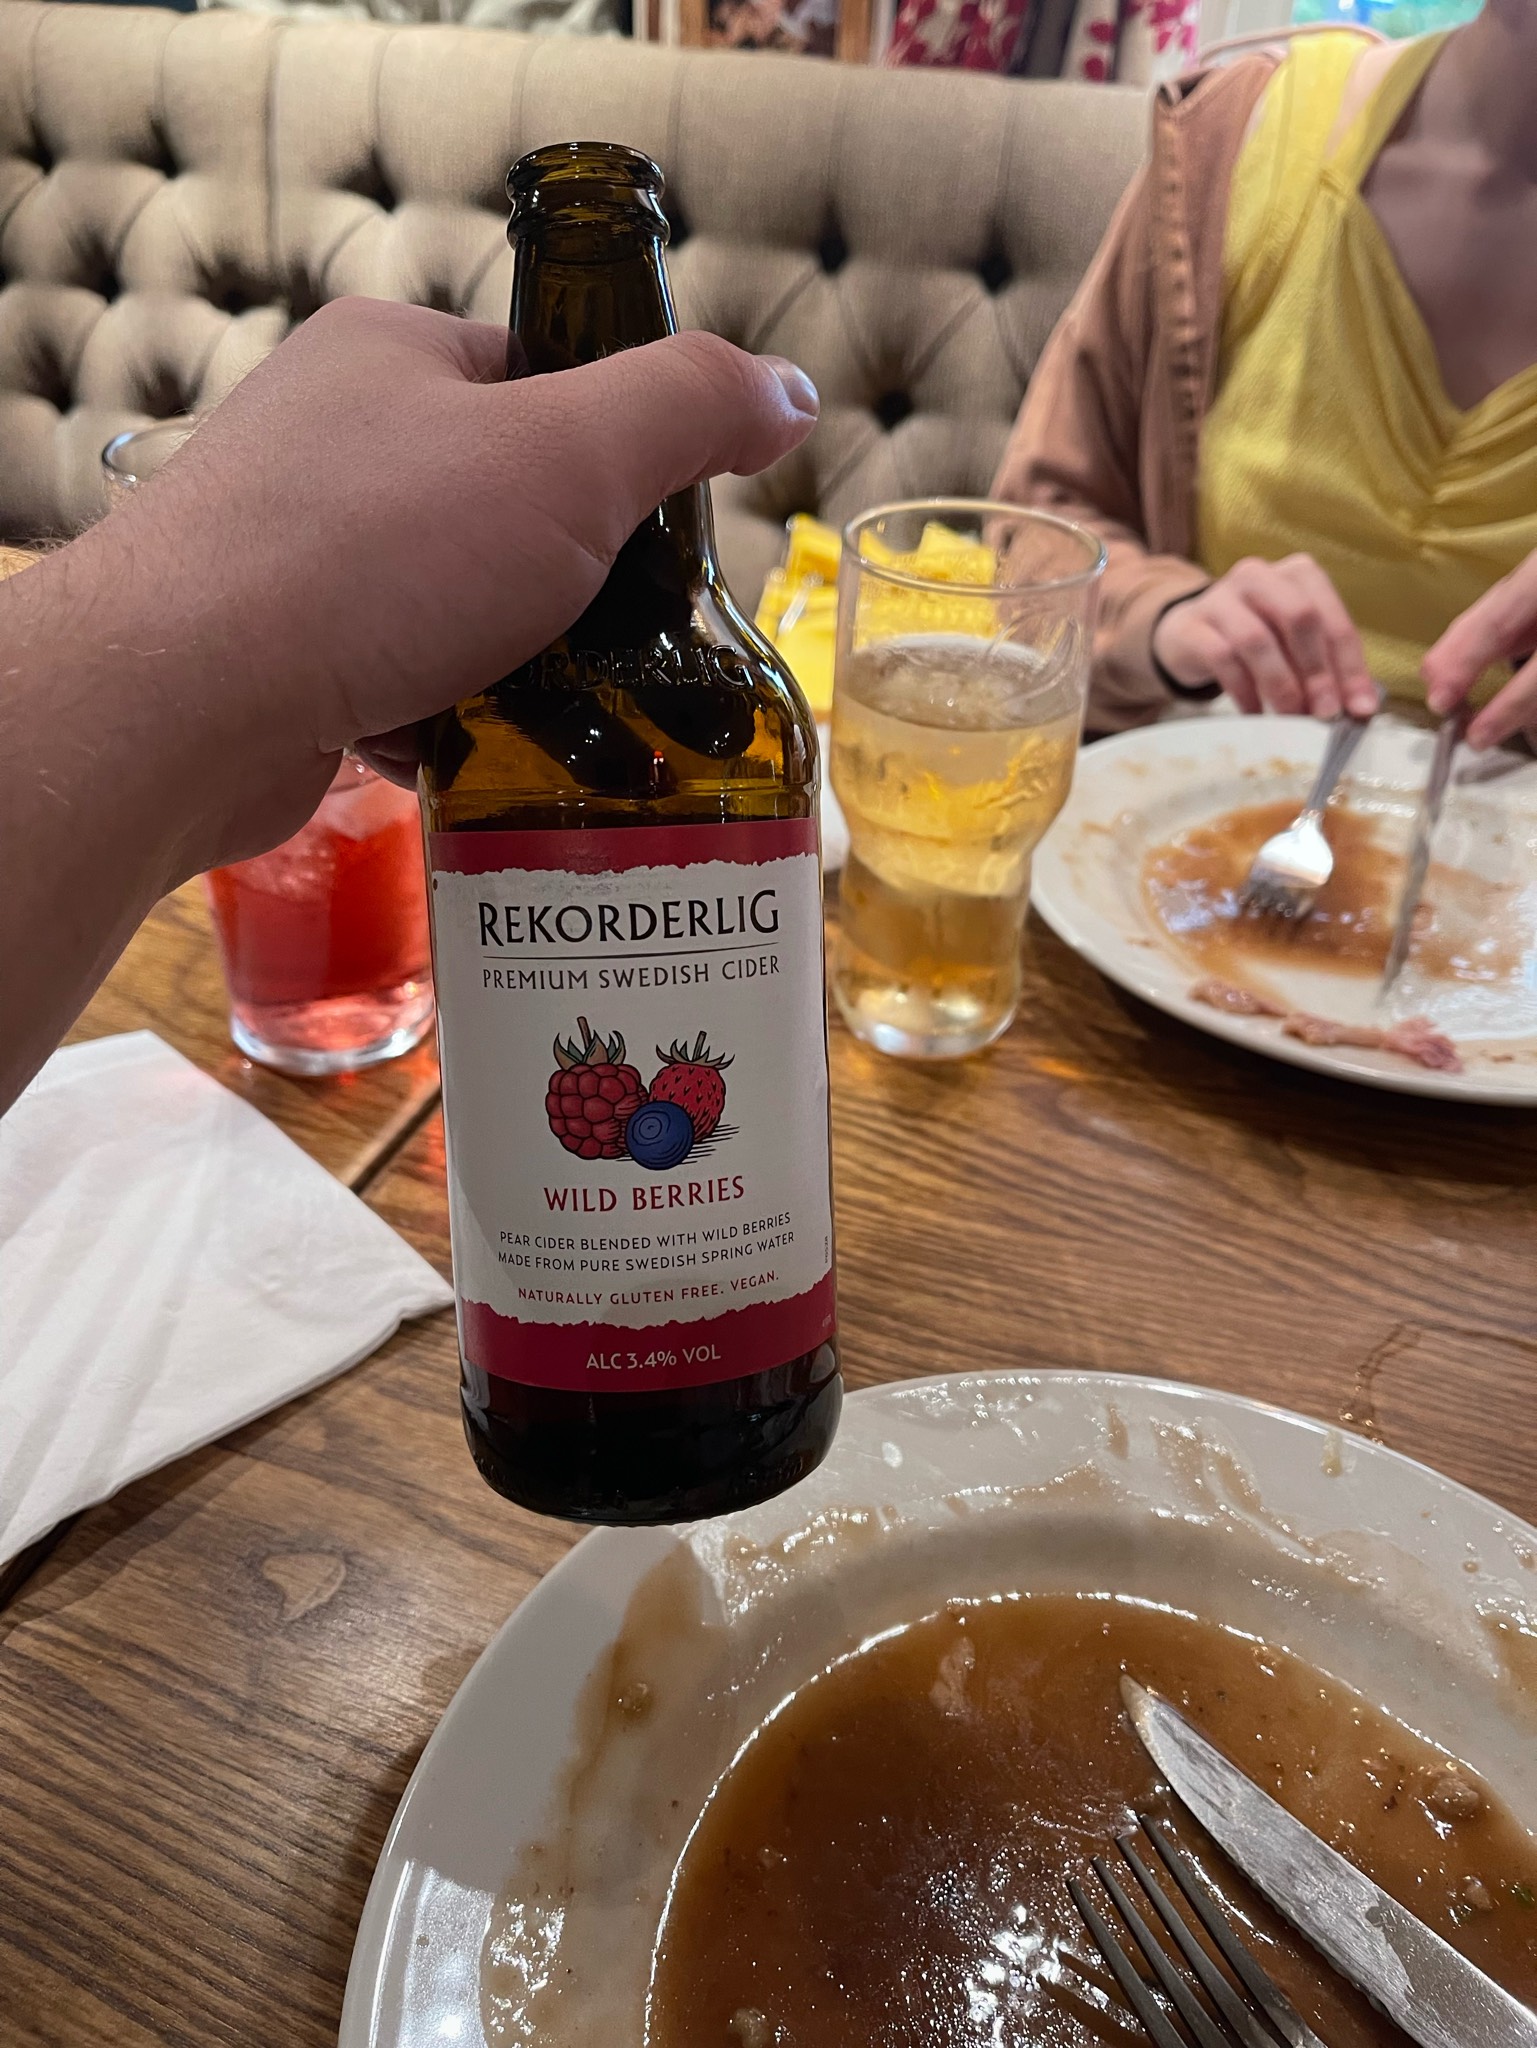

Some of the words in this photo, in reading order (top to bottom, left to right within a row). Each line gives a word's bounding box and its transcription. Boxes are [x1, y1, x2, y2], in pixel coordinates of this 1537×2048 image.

[478, 890, 778, 946] REKORDERLIG
[483, 969, 587, 989] PREMIUM
[599, 964, 708, 988] SWEDISH
[722, 956, 779, 979] CIDER
[544, 1188, 616, 1212] WILD
[633, 1176, 744, 1210] BERRIES
[501, 1231, 530, 1246] PEAR
[535, 1237, 574, 1249] CIDER
[581, 1237, 650, 1250] BLENDED
[657, 1232, 696, 1247] WITH
[702, 1227, 737, 1241] WILD
[743, 1212, 791, 1235] BERRIES
[499, 1252, 530, 1267] MADE
[536, 1257, 574, 1270] FROM
[581, 1260, 619, 1271] PURE
[626, 1254, 695, 1270] SWEDISH
[702, 1244, 752, 1263] SPRING
[757, 1231, 795, 1252] WATER
[519, 1288, 602, 1304] NATURALLY
[610, 1290, 673, 1304] GLUTEN
[682, 1284, 723, 1299] FREE.
[730, 1271, 778, 1291] VEGAN.
[587, 1353, 621, 1369] ALC
[627, 1351, 676, 1369] 3.4%
[683, 1344, 721, 1363] VOL
